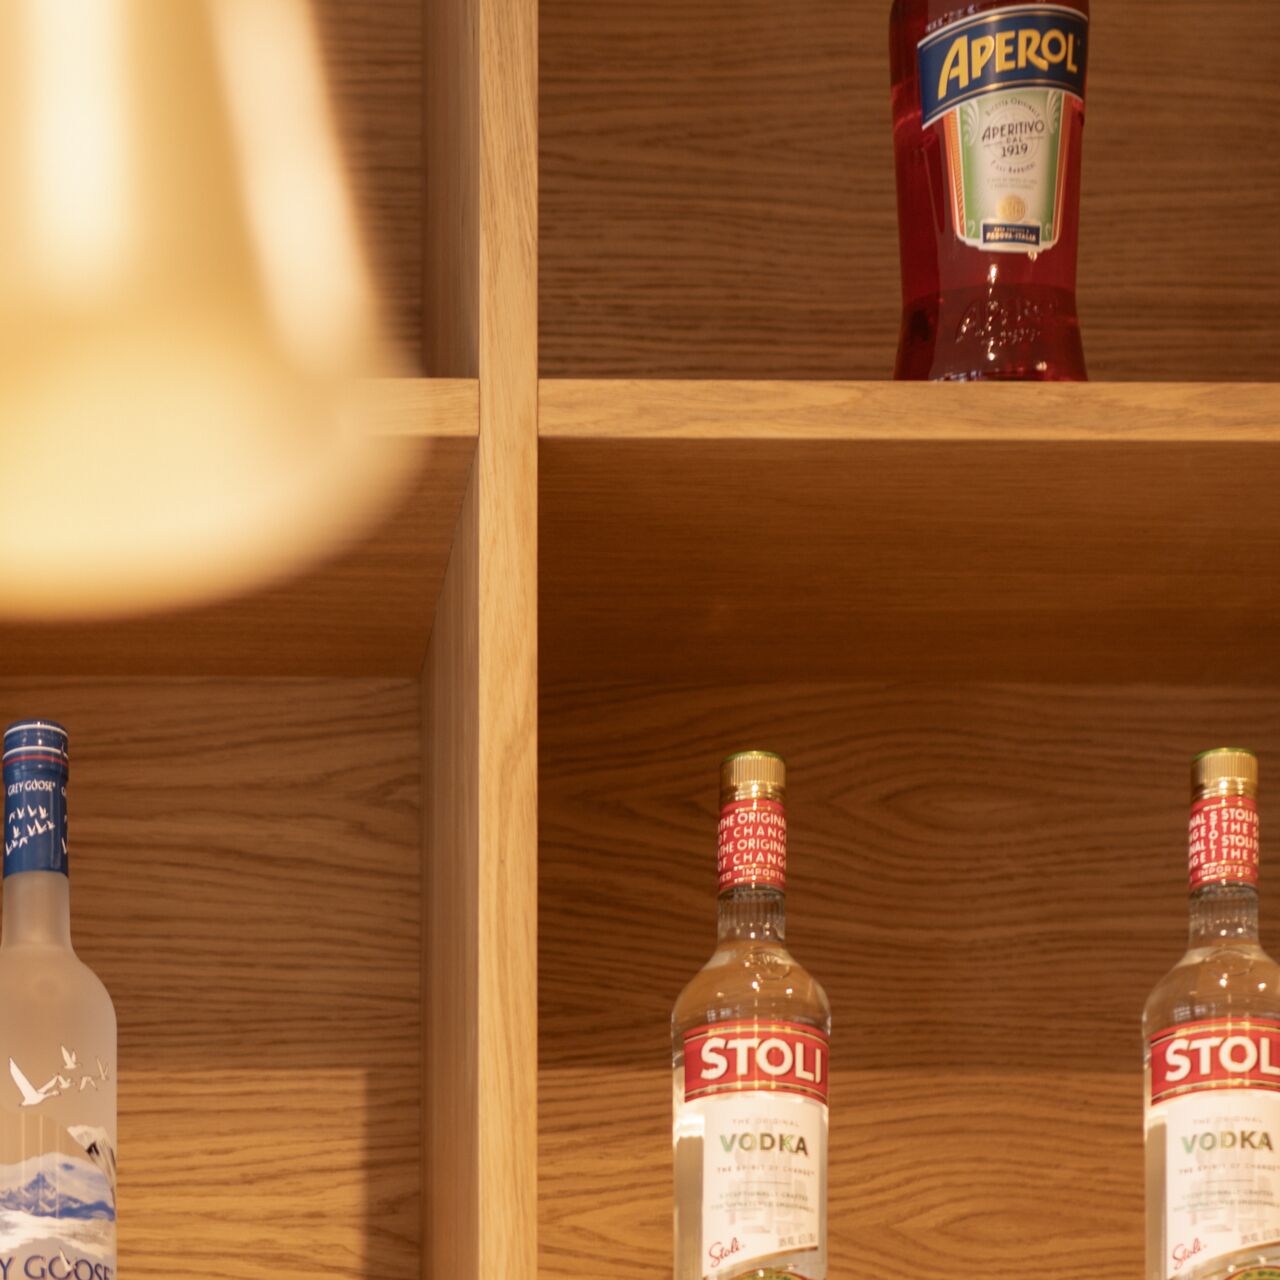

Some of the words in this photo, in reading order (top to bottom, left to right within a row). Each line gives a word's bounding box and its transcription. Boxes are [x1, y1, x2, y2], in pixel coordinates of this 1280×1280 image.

[937, 28, 1078, 100] APEROL
[981, 119, 1045, 142] APERITIVO
[1002, 143, 1028, 158] 1919
[7, 781, 24, 798] GREY
[25, 779, 54, 792] GOOSE
[1221, 821, 1249, 835] THE
[1221, 847, 1249, 860] THE
[700, 1037, 822, 1084] STOLI
[1165, 1035, 1280, 1082] STOL
[720, 1132, 808, 1156] VODKA
[1181, 1130, 1273, 1155] VODKA
[709, 1237, 740, 1268] Stoli
